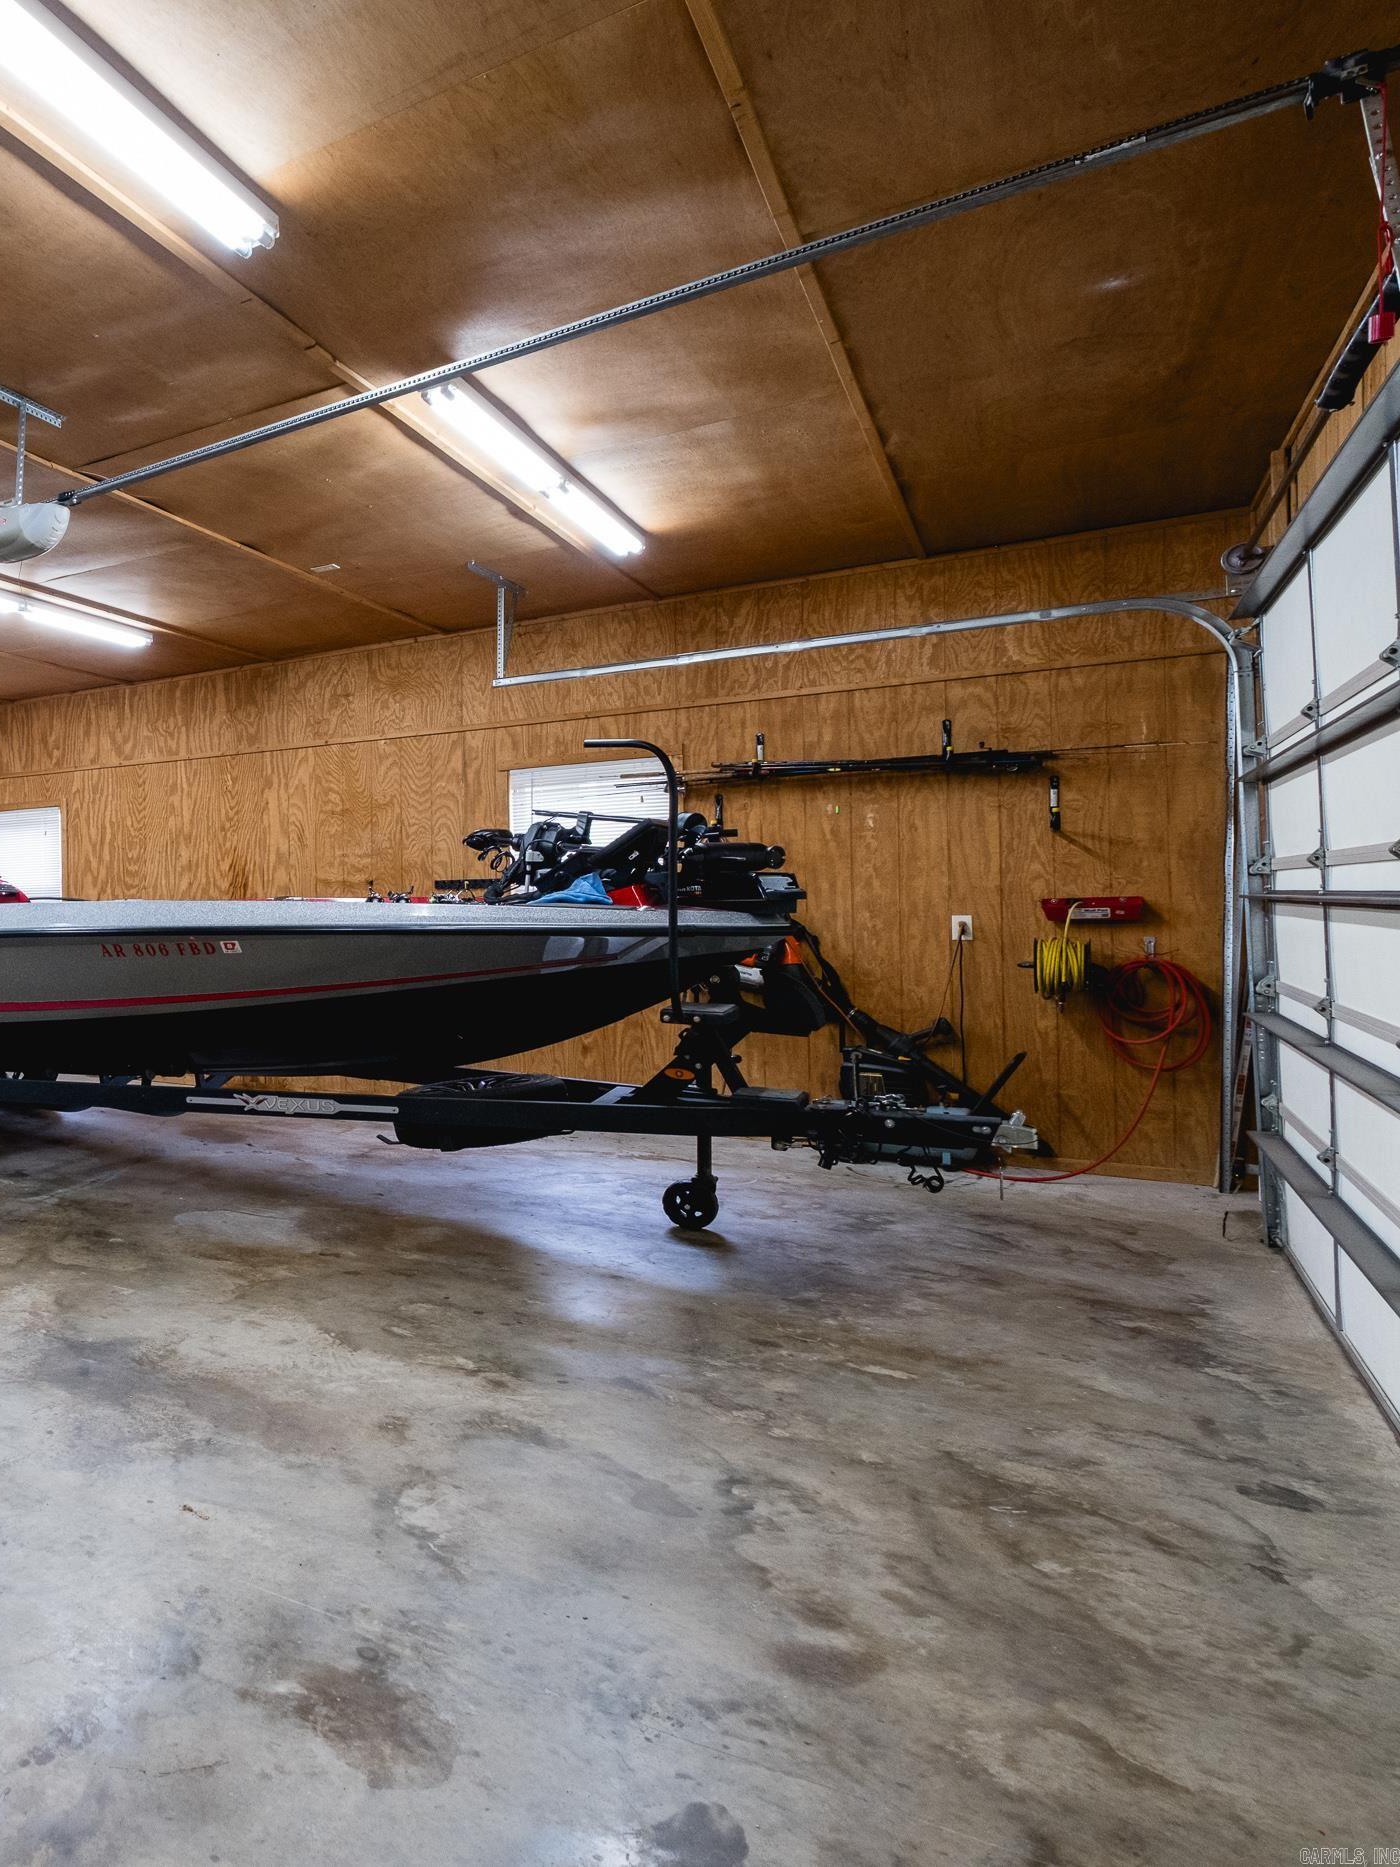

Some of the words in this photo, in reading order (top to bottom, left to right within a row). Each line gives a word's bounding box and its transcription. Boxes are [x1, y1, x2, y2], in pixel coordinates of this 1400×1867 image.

[100, 943, 126, 958] AR
[132, 943, 170, 957] 806
[263, 1097, 335, 1113] VEXUS
